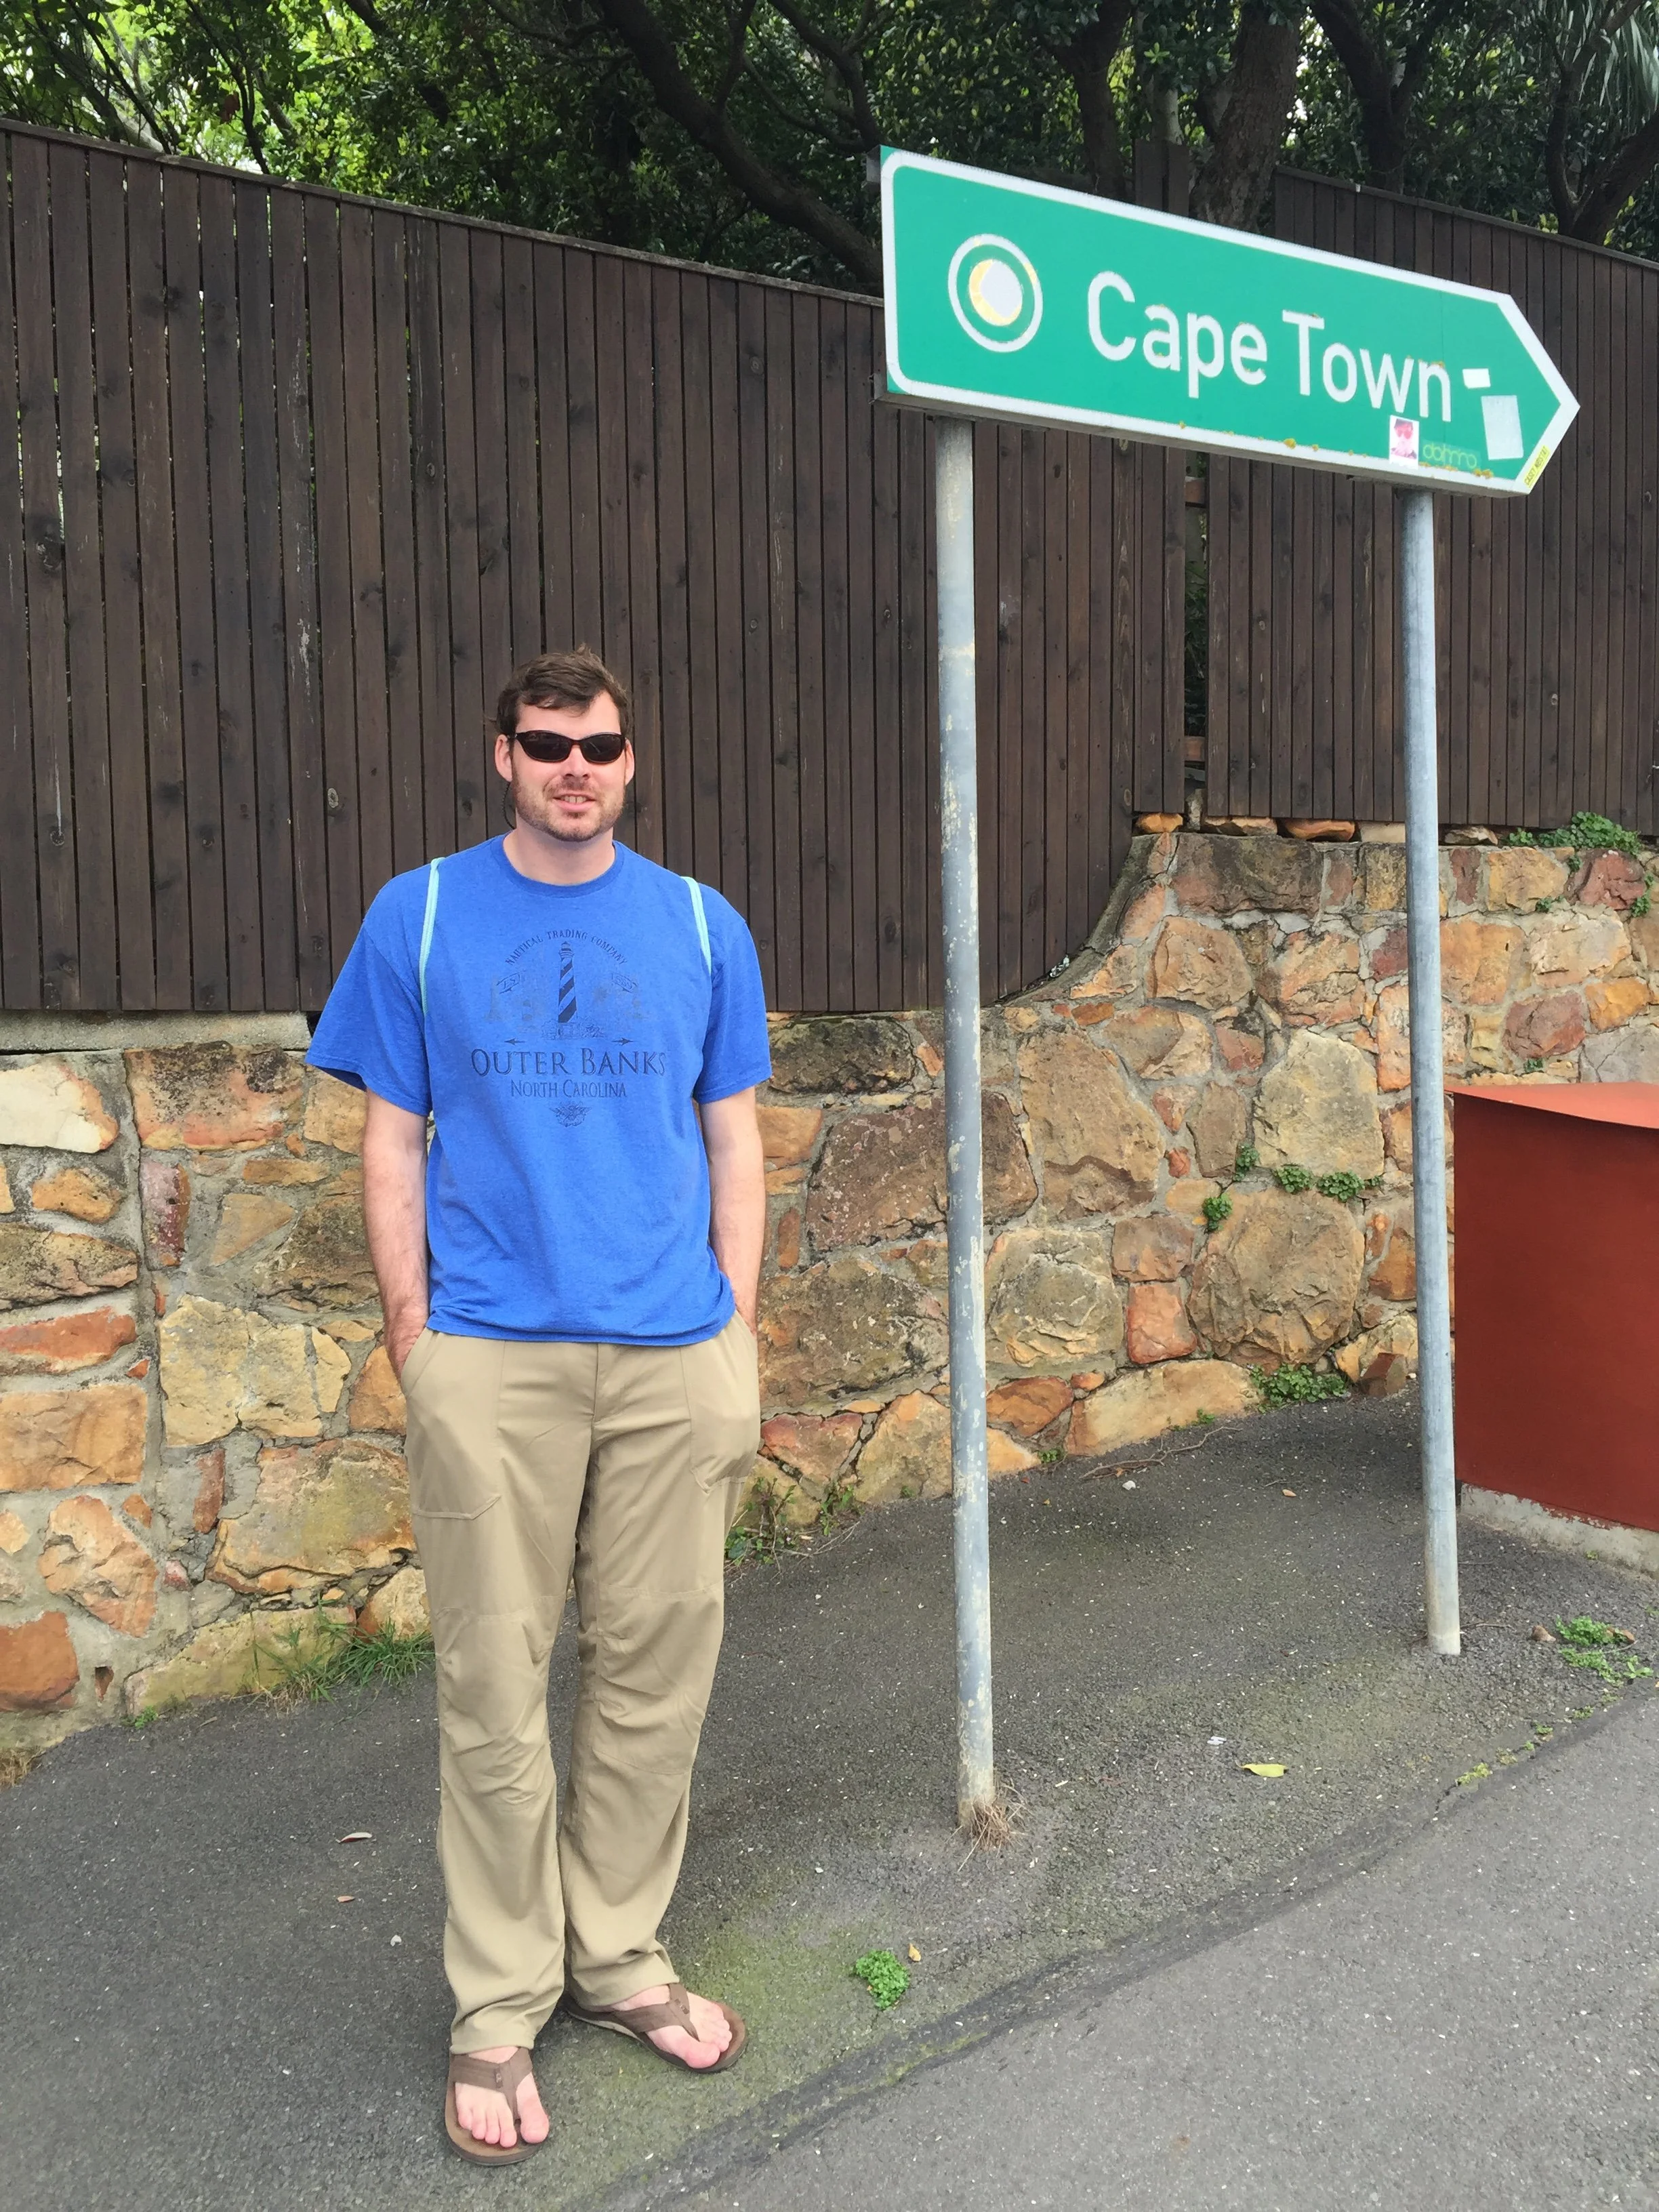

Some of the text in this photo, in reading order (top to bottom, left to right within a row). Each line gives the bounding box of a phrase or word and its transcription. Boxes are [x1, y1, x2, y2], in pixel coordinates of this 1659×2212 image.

[1087, 270, 1452, 422] Cape Town
[505, 929, 628, 966] NAUTICAL TRADING COMPANY
[470, 1047, 667, 1078] OUTER BANKS
[510, 1079, 627, 1098] NORTH CAROLINA
